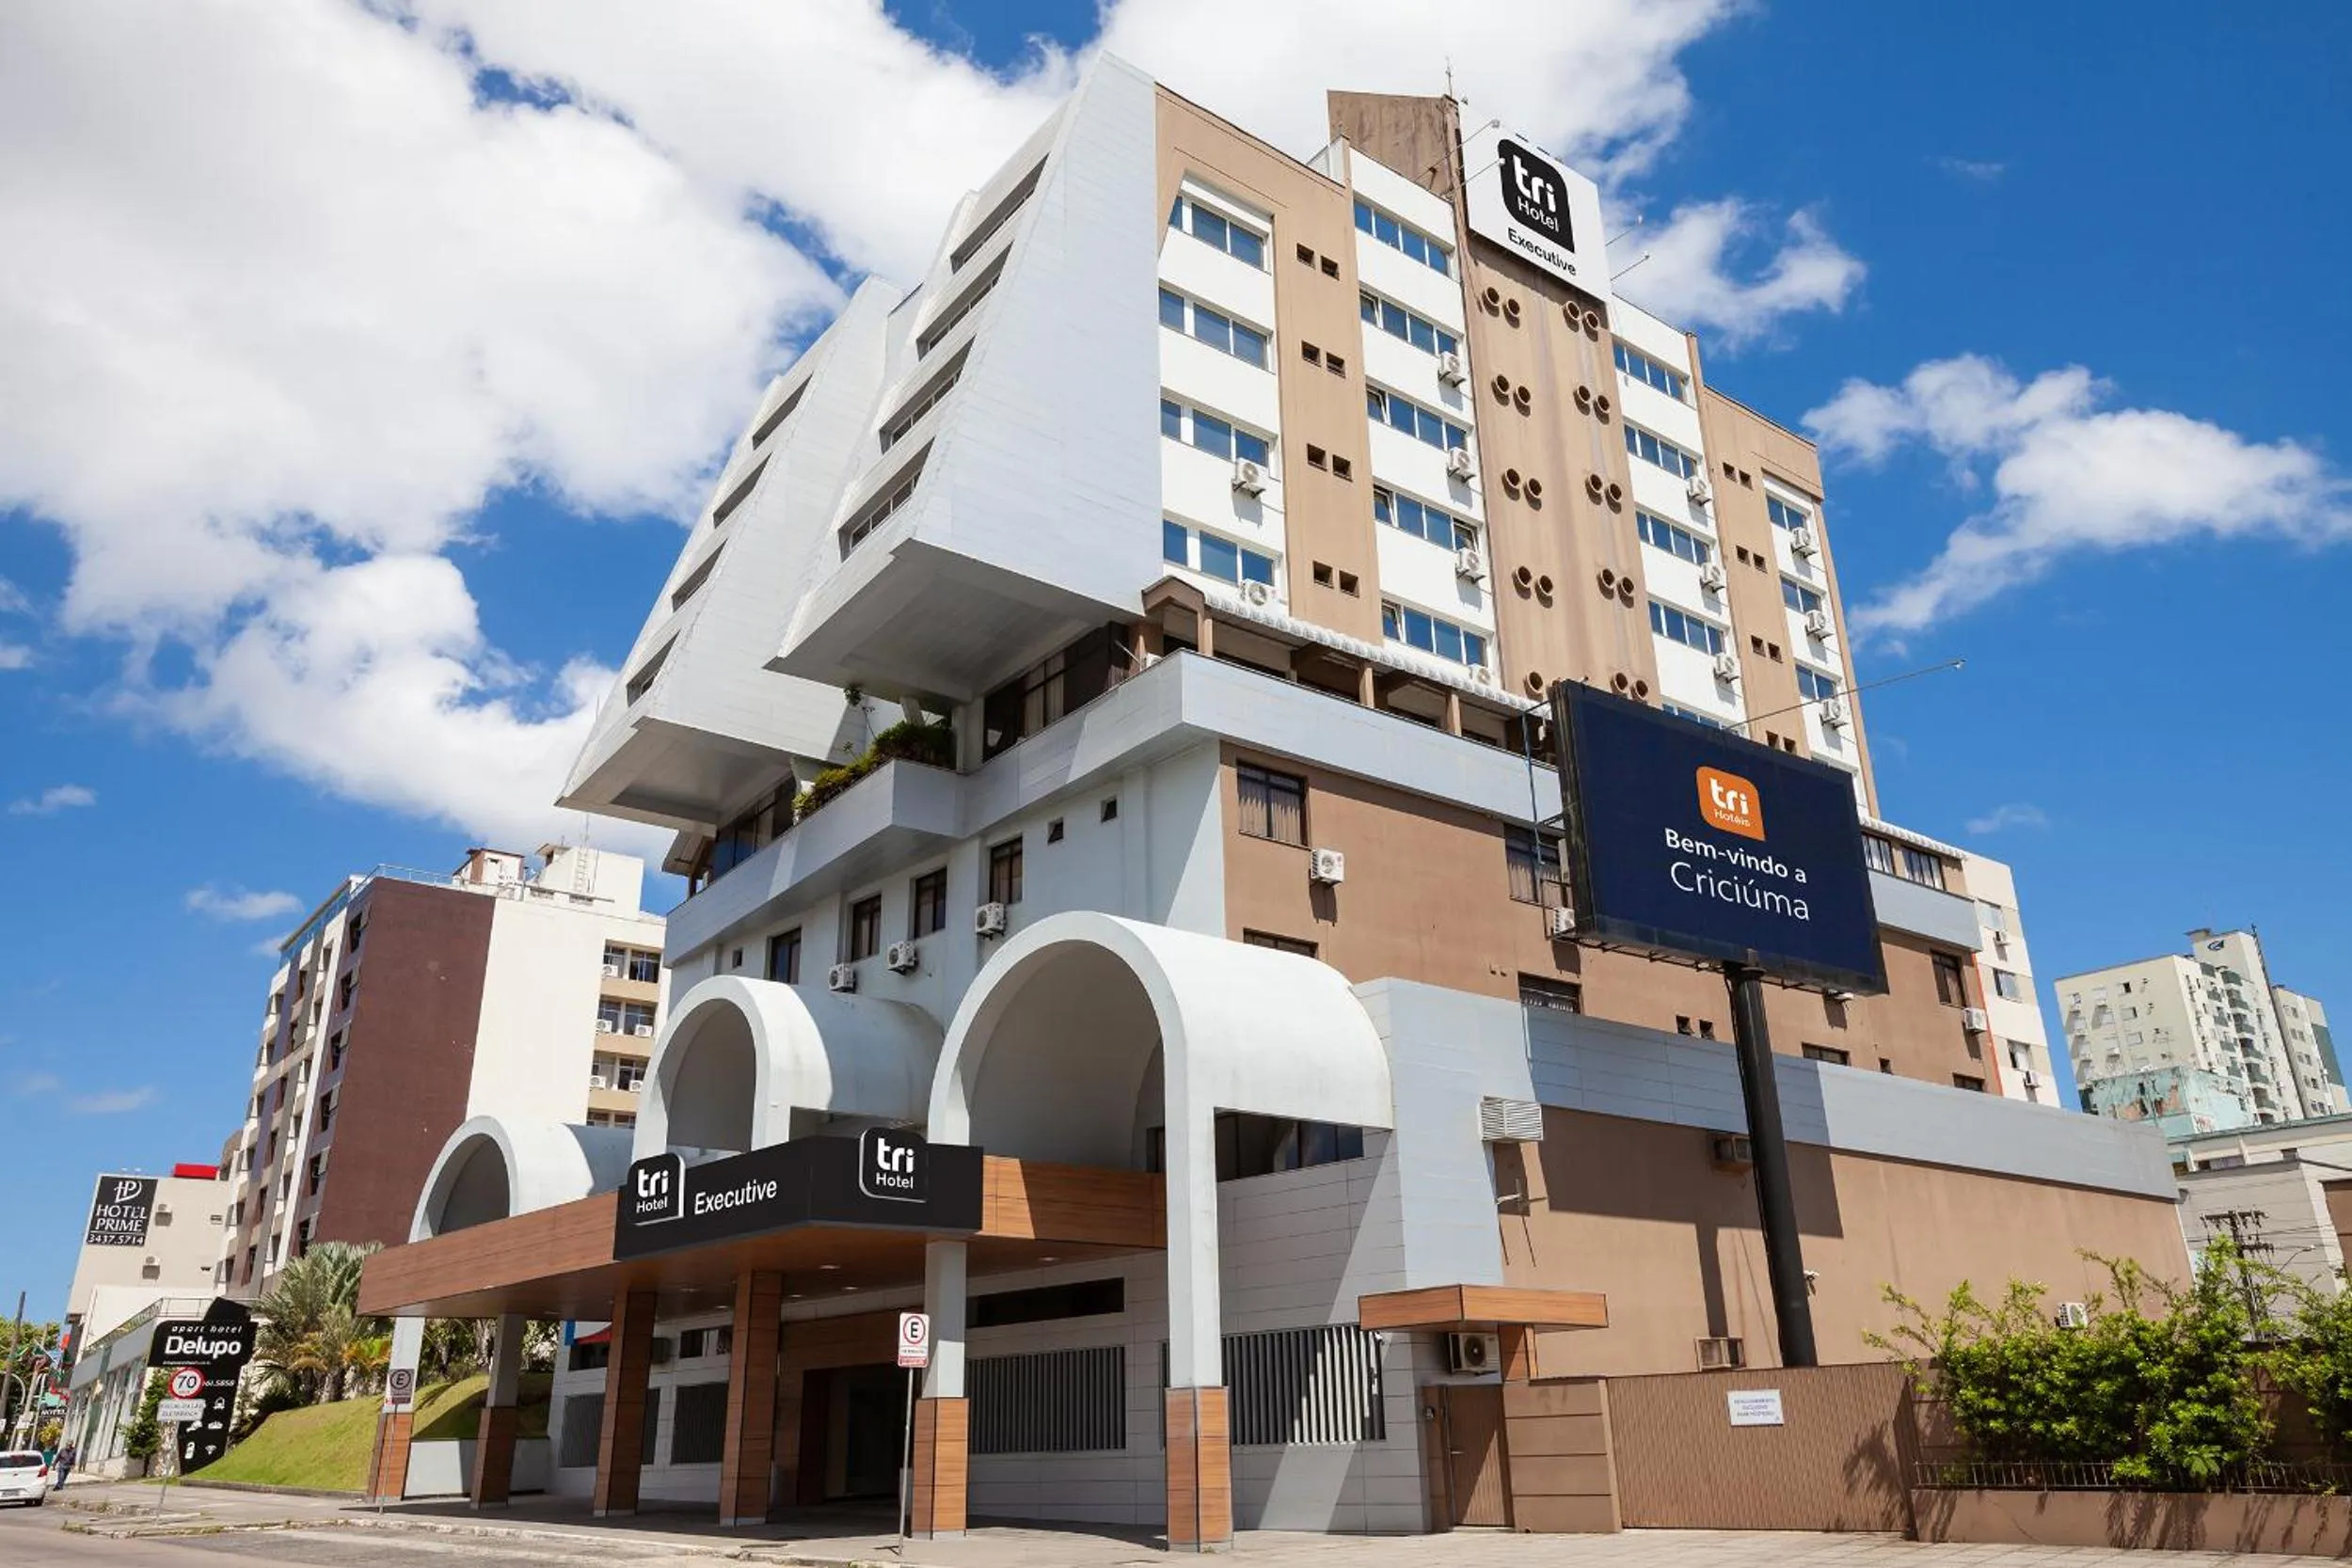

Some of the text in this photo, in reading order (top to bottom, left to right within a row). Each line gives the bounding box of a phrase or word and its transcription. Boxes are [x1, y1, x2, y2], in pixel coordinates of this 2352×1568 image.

[1513, 154, 1556, 212] tri
[1518, 196, 1559, 232] Hotel
[1508, 227, 1576, 276] Executive
[1709, 777, 1749, 815] tri
[1664, 827, 1806, 883] Bem-vindo a
[1670, 861, 1810, 921] Criciúma
[877, 1137, 914, 1173] tri
[638, 1168, 669, 1197] tri
[876, 1172, 914, 1189] Hotel
[96, 1204, 147, 1219] HOTEL
[636, 1196, 668, 1213] Hotel
[694, 1179, 777, 1215] Executive
[95, 1217, 143, 1231] PRIME
[910, 1322, 919, 1338] E
[165, 1336, 241, 1359] Delupo
[177, 1376, 197, 1389] 70
[396, 1373, 405, 1385] E
